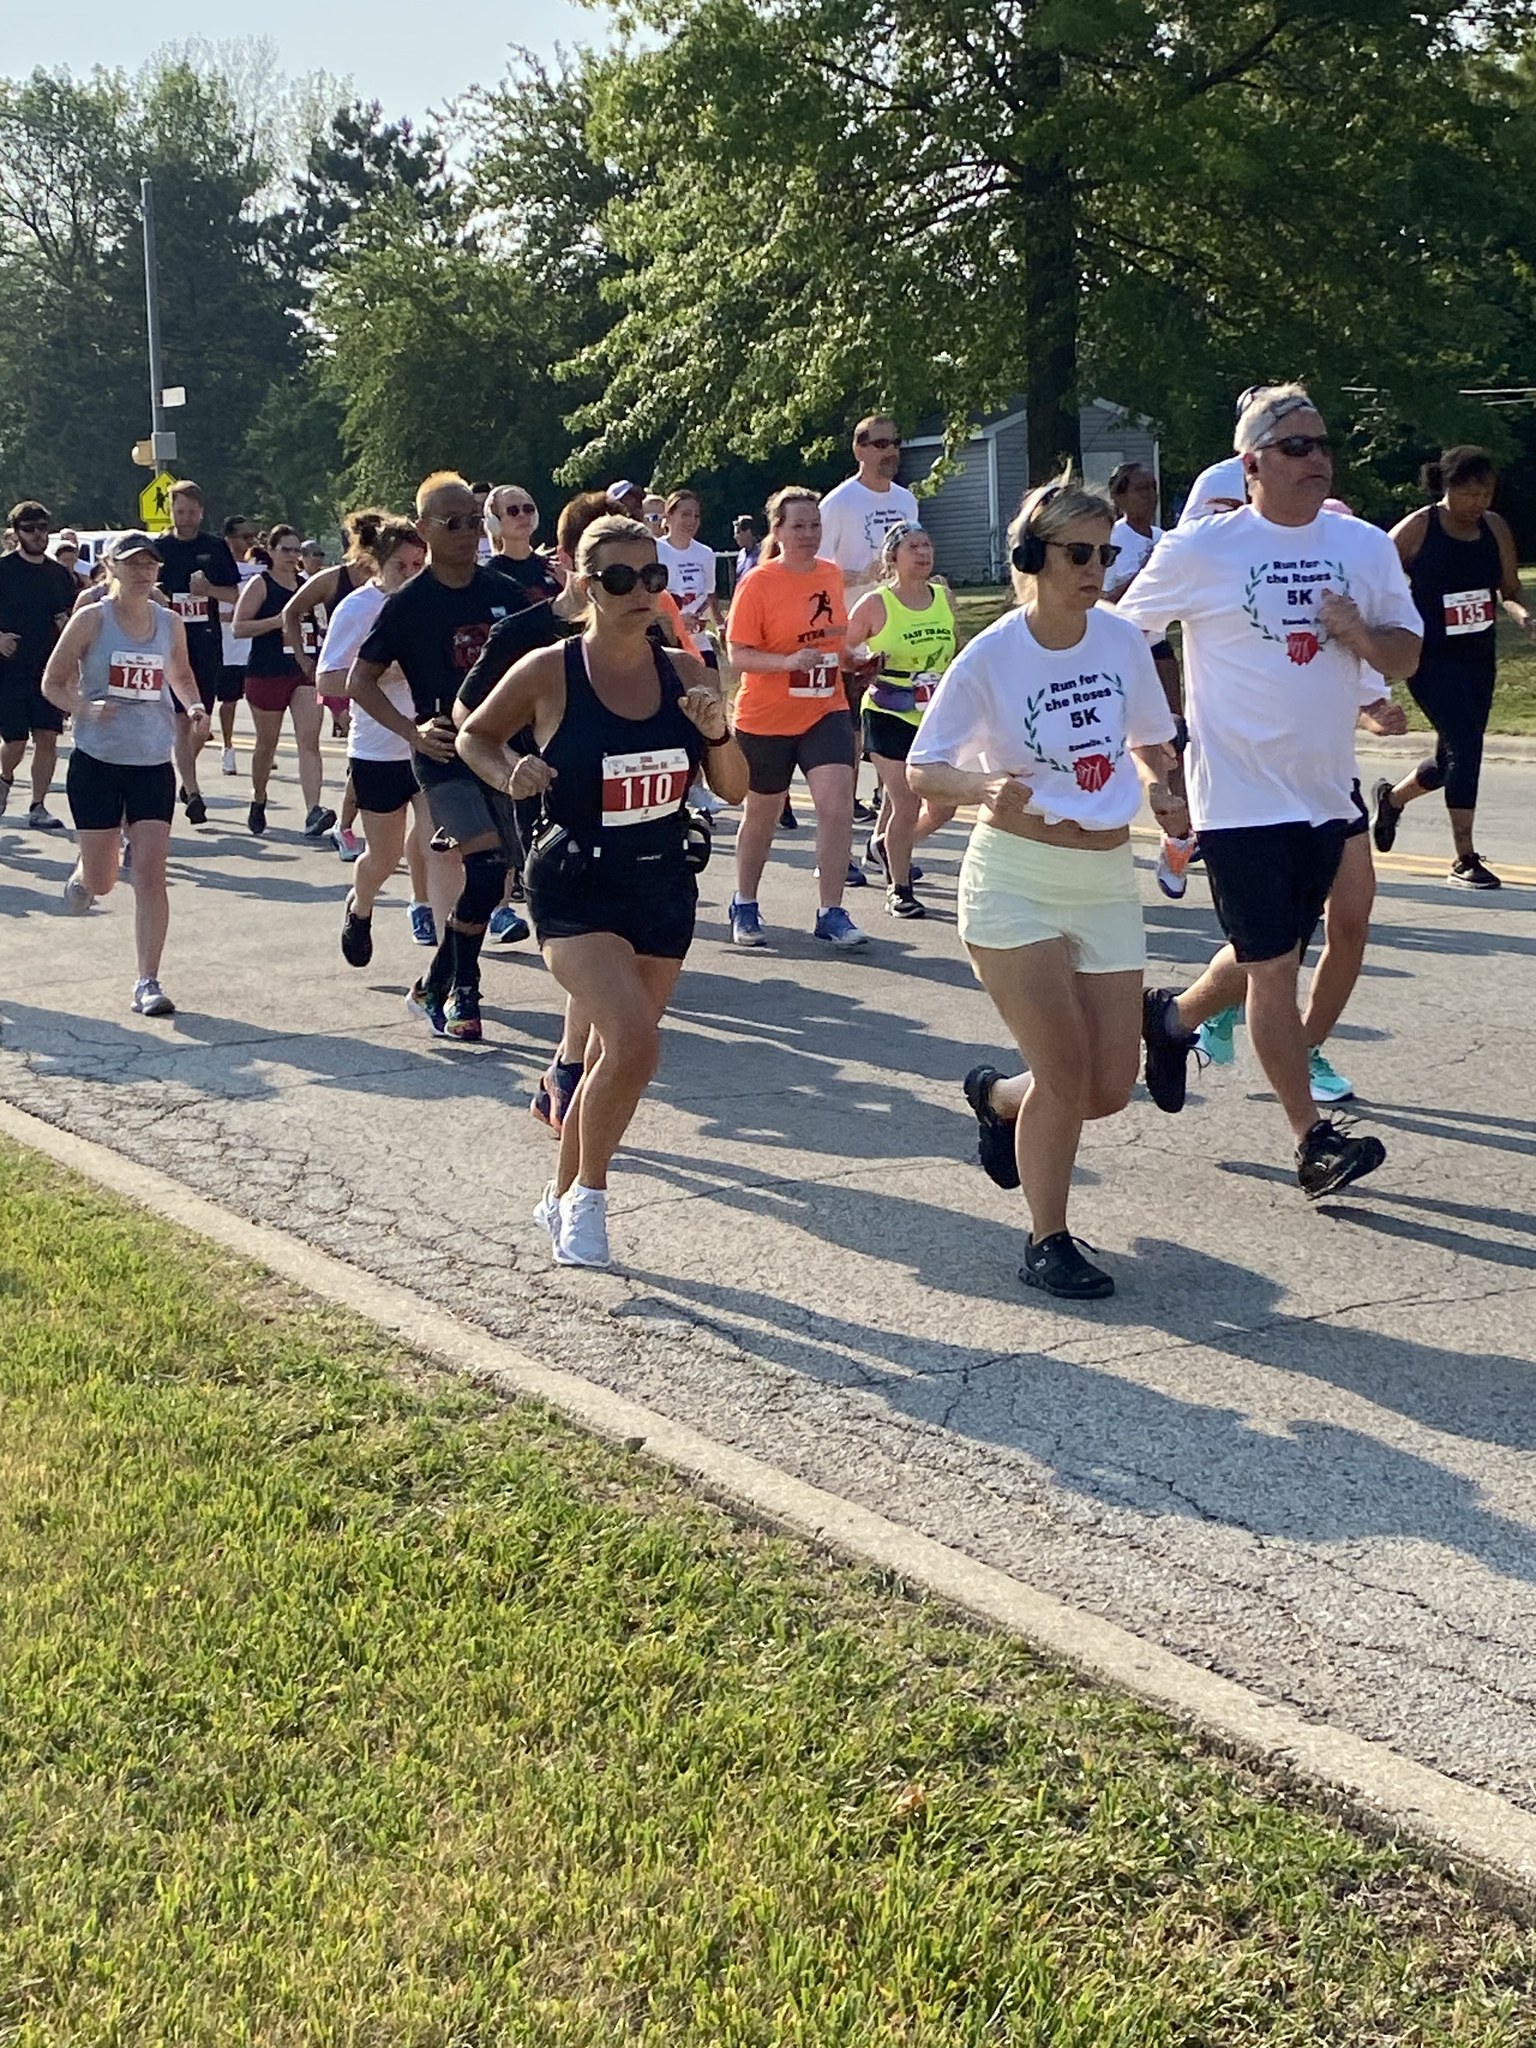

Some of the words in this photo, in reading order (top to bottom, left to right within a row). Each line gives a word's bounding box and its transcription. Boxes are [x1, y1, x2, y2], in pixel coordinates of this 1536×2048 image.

[1272, 560, 1298, 570] Run
[1300, 559, 1320, 569] for
[1266, 573, 1289, 584] the
[1292, 572, 1332, 583] Roses
[1287, 588, 1313, 606] 5K
[1455, 602, 1486, 626] 135
[121, 666, 154, 690] 143
[1050, 680, 1077, 694] Run
[1079, 674, 1099, 686] for
[1044, 698, 1070, 712] the
[1072, 687, 1112, 704] Roses
[1070, 707, 1101, 728] 5K
[621, 773, 673, 810] 110
